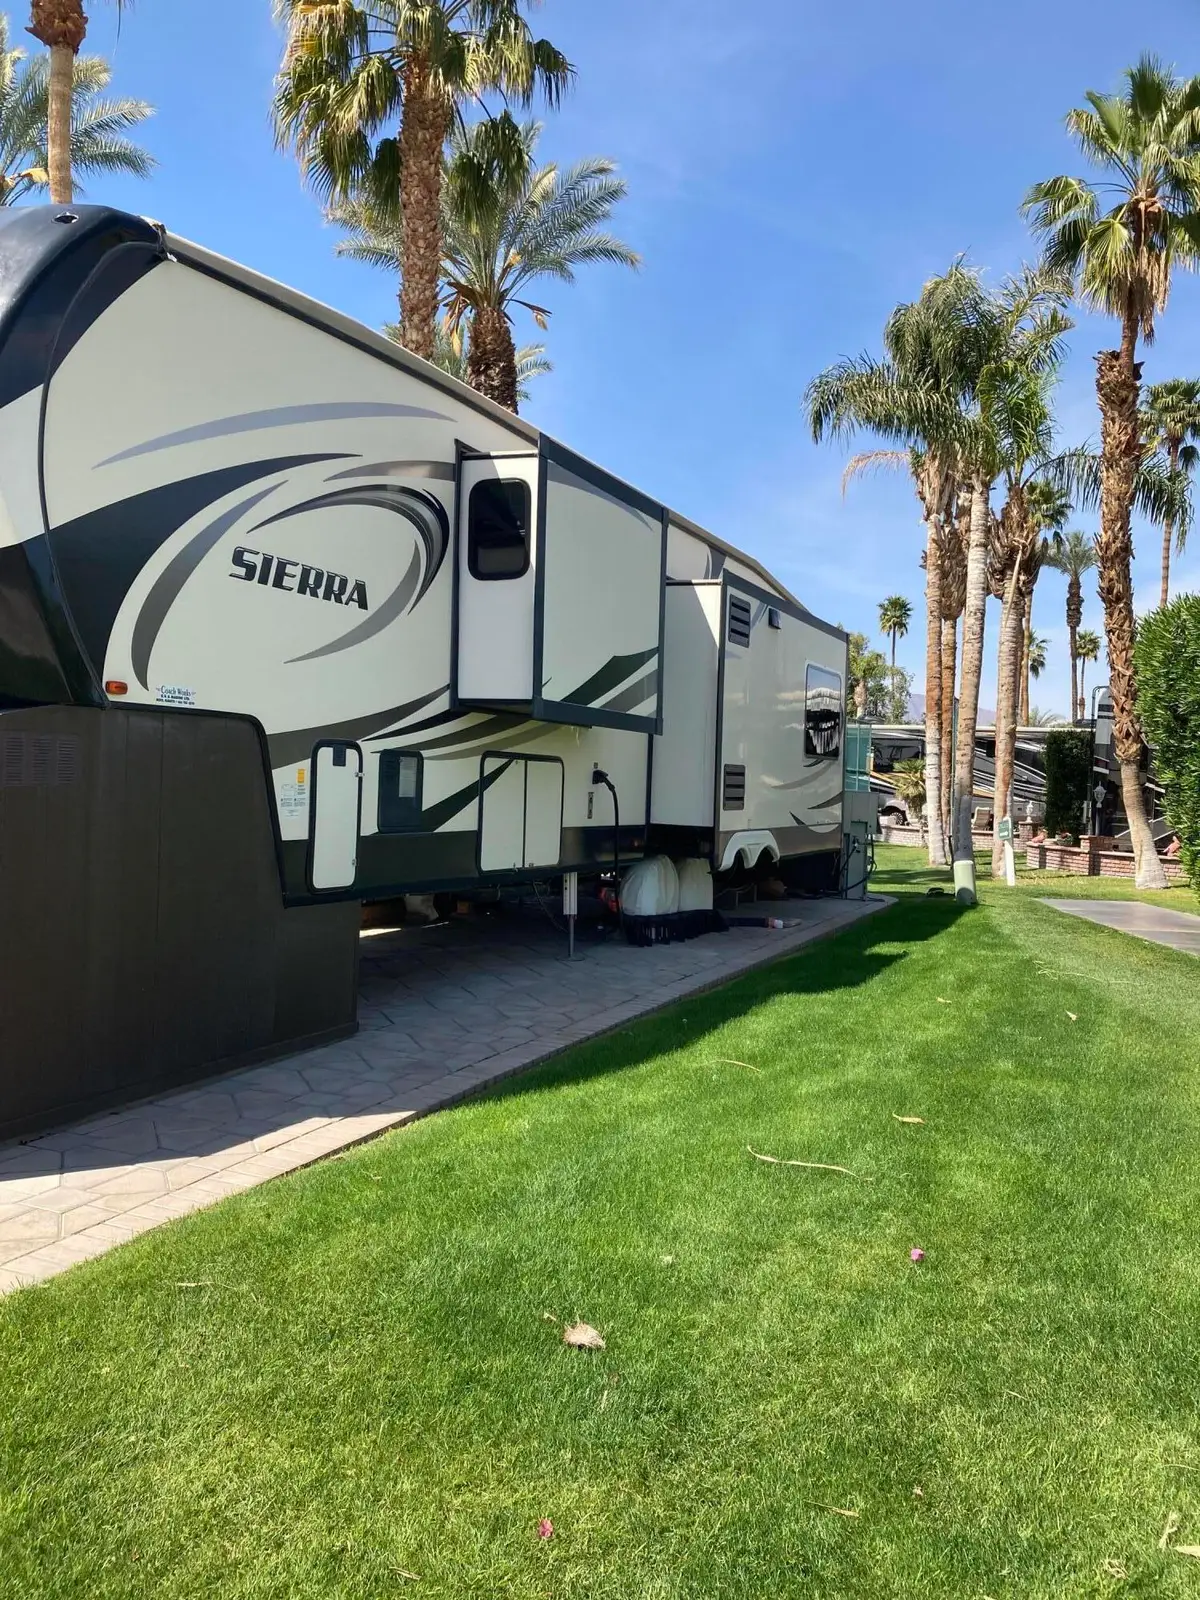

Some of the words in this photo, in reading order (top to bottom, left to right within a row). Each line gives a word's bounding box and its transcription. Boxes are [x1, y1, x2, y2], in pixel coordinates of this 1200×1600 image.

[229, 546, 369, 611] SIERRA
[161, 685, 176, 694] Coach
[177, 688, 191, 696] Works
